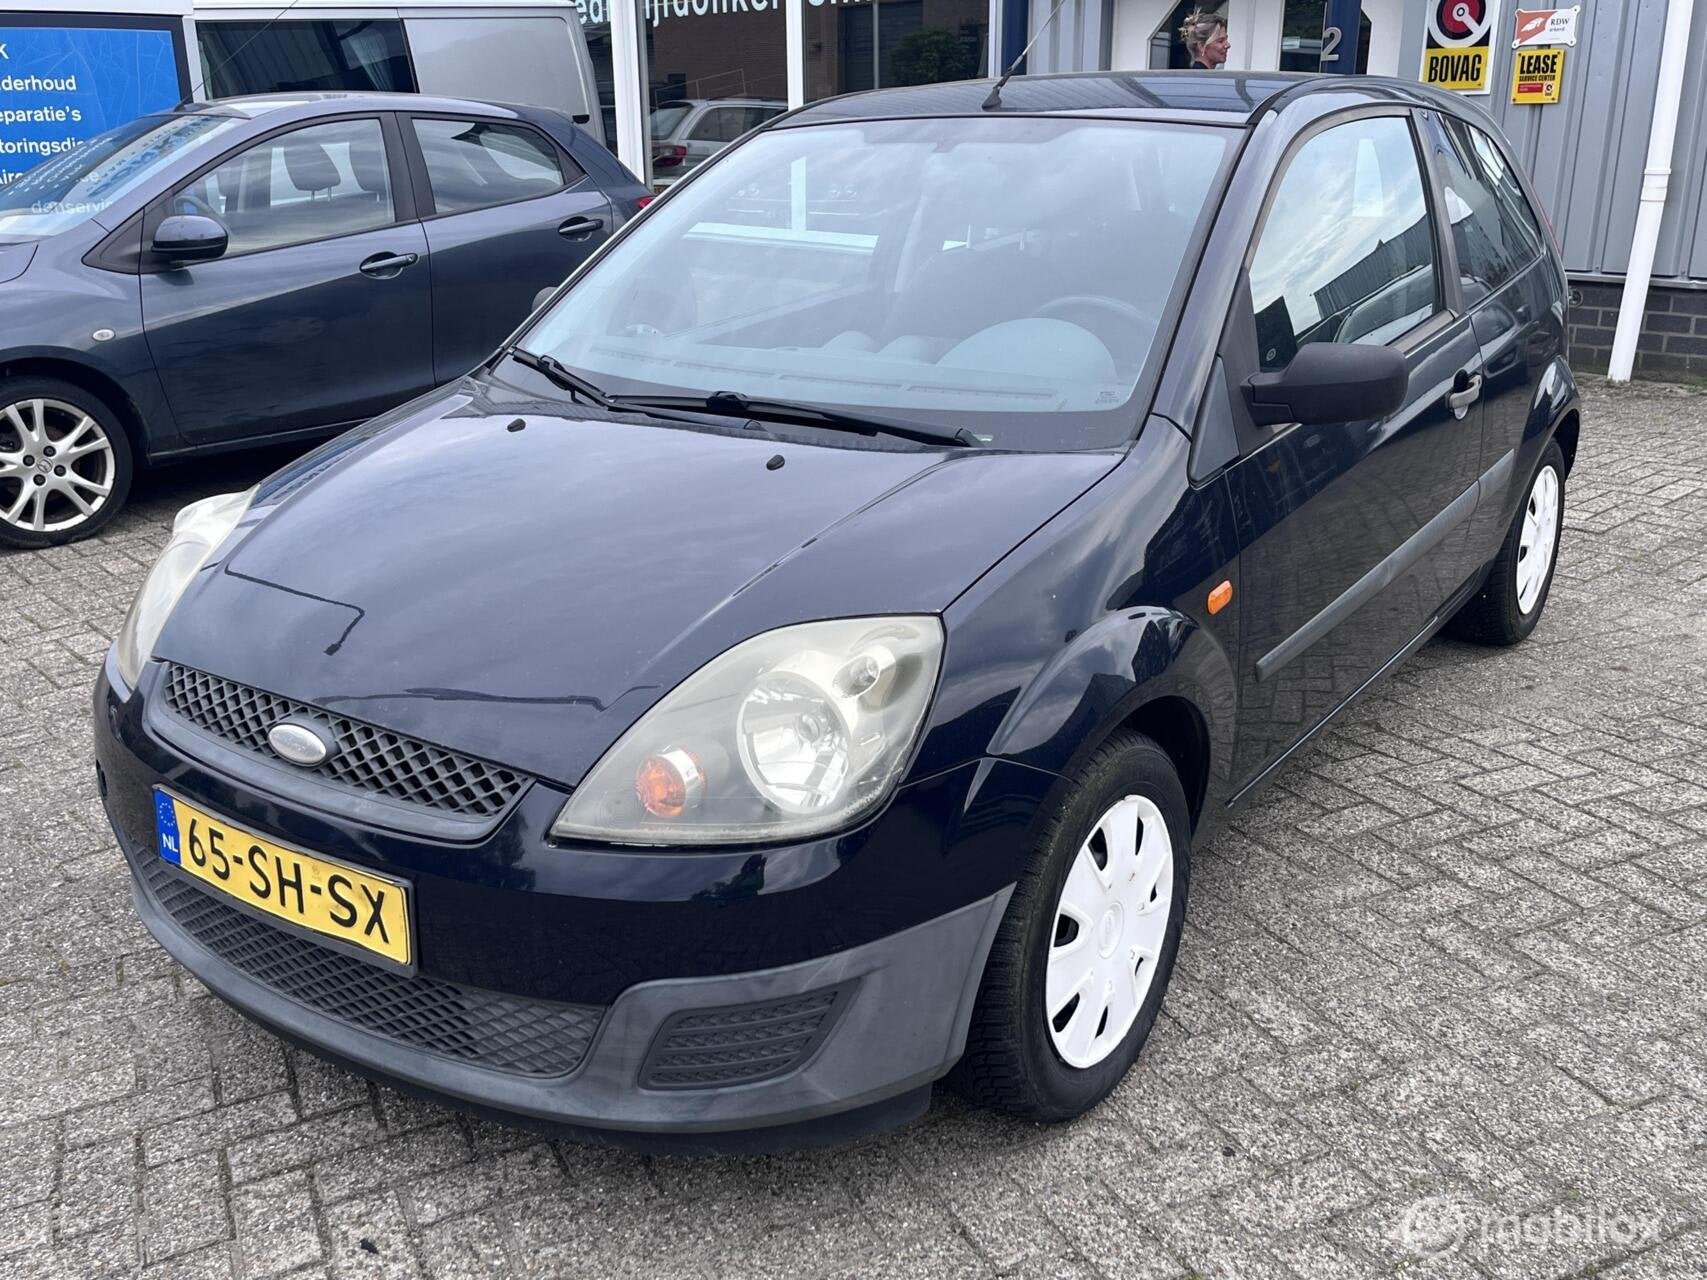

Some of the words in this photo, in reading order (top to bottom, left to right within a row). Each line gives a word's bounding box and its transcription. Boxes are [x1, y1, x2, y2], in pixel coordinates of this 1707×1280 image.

[1550, 18, 1570, 26] RDW
[1321, 27, 1342, 61] 2
[1428, 54, 1482, 83] BOVAG
[1519, 54, 1558, 75] LEASE
[0, 75, 77, 91] derhoud
[1538, 74, 1556, 82] CENTER
[162, 832, 178, 853] NL
[188, 818, 389, 944] 65-SH-SX
